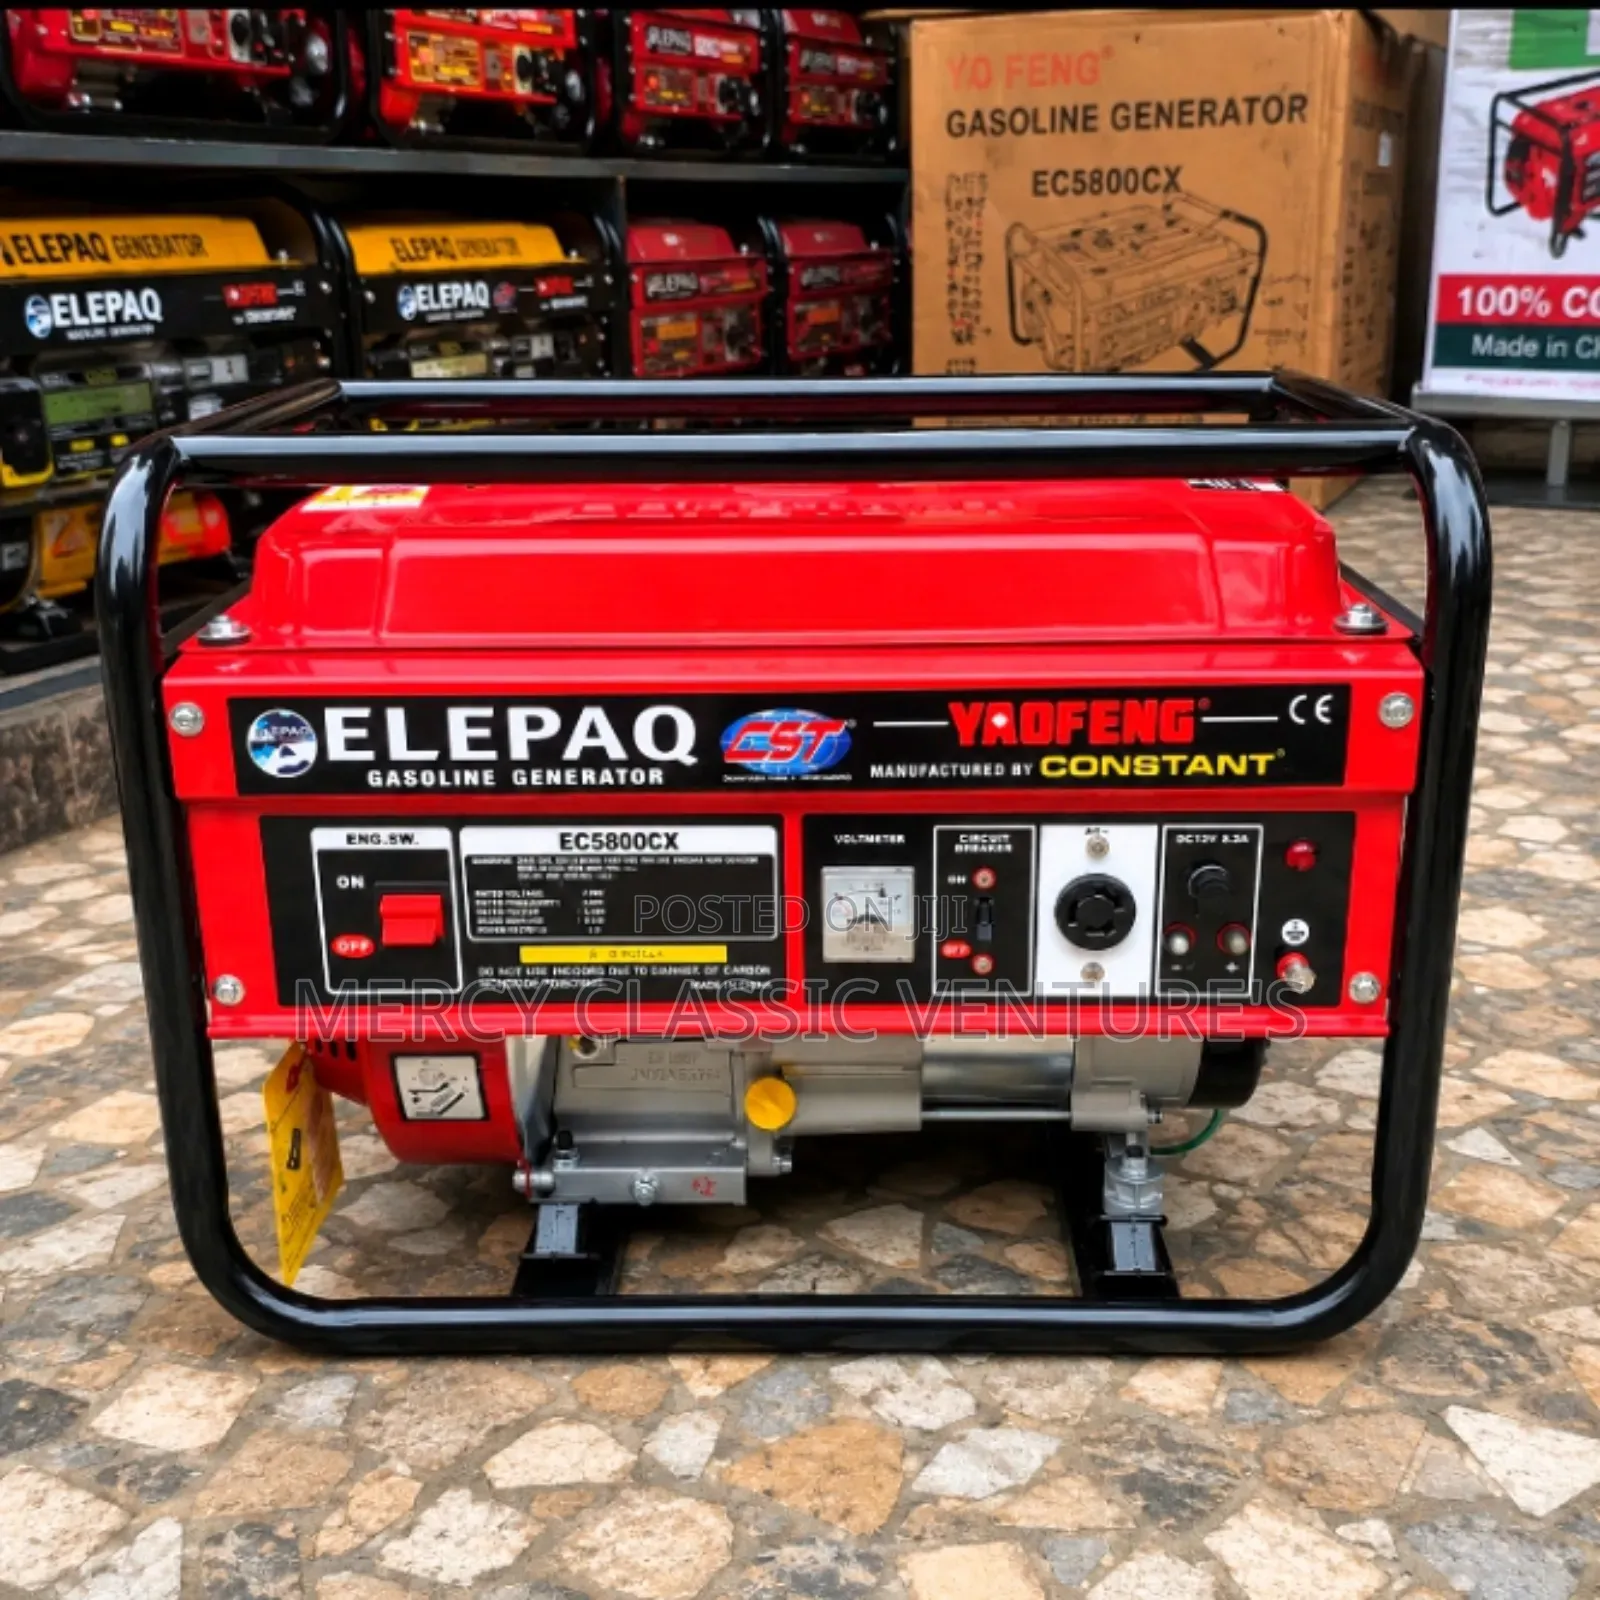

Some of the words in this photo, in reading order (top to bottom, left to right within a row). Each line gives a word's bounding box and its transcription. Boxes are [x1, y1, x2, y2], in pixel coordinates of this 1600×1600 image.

[1005, 50, 1100, 90] FENG
[946, 104, 1099, 138] GASOLINE
[1110, 94, 1309, 132] GENERATOR
[1032, 165, 1183, 198] EC5800CX
[10, 231, 112, 264] ELEPAQ
[50, 287, 163, 328] ELEPAQ
[414, 280, 490, 312] ELEPAQ
[1457, 284, 1552, 319] 100%
[1471, 333, 1539, 358] Made
[1546, 333, 1568, 359] in
[948, 699, 1195, 746] YAOFENG
[1288, 693, 1334, 725] CE
[323, 704, 699, 767] ELEPAQ
[367, 768, 497, 788] GASOLINE
[512, 767, 664, 786] GENERATOR
[870, 762, 1005, 779] MANUFACTURED
[1011, 762, 1034, 777] BY
[1039, 754, 1275, 778] CONSTANT
[558, 831, 679, 851] EC5800CX
[834, 834, 906, 845] VOLTMETER
[954, 844, 1013, 853] BREAKER
[958, 833, 1011, 844] CIRCUIT
[336, 875, 365, 889] ON
[336, 941, 369, 953] OFF
